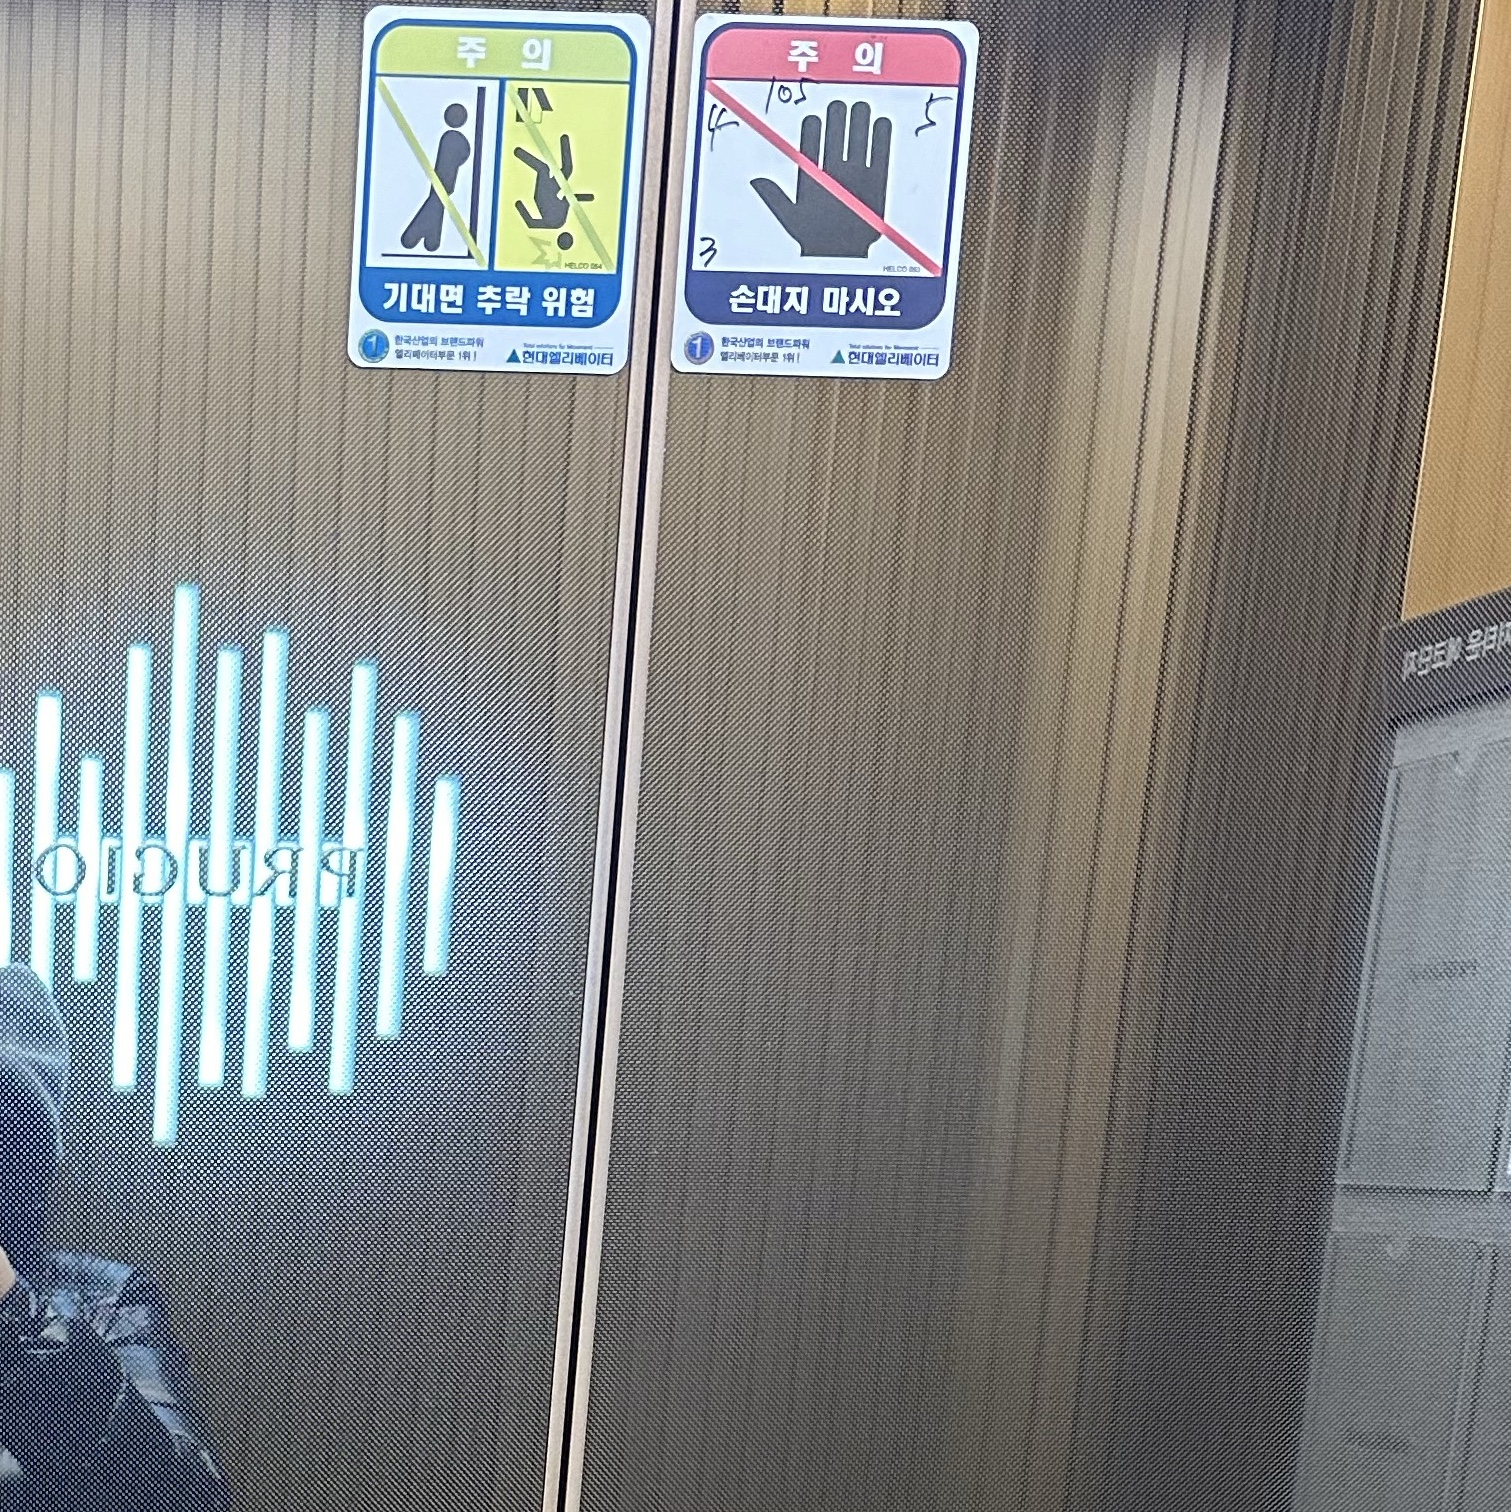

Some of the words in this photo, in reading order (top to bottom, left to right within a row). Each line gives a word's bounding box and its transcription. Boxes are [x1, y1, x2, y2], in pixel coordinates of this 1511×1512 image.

[457, 37, 486, 68] 주
[522, 38, 551, 70] 의
[788, 40, 818, 73] 주
[854, 42, 883, 74] 의
[765, 75, 821, 114] 105
[699, 237, 718, 267] 3
[384, 282, 464, 314] 기대면
[477, 285, 530, 316] 추락
[542, 287, 596, 318] 위험
[729, 284, 808, 314] 손대지
[822, 287, 901, 316] 마시오
[395, 335, 438, 347] 한국산업의
[522, 350, 614, 366] 현대엘리베이터
[848, 351, 939, 367] 현대엘리베이터
